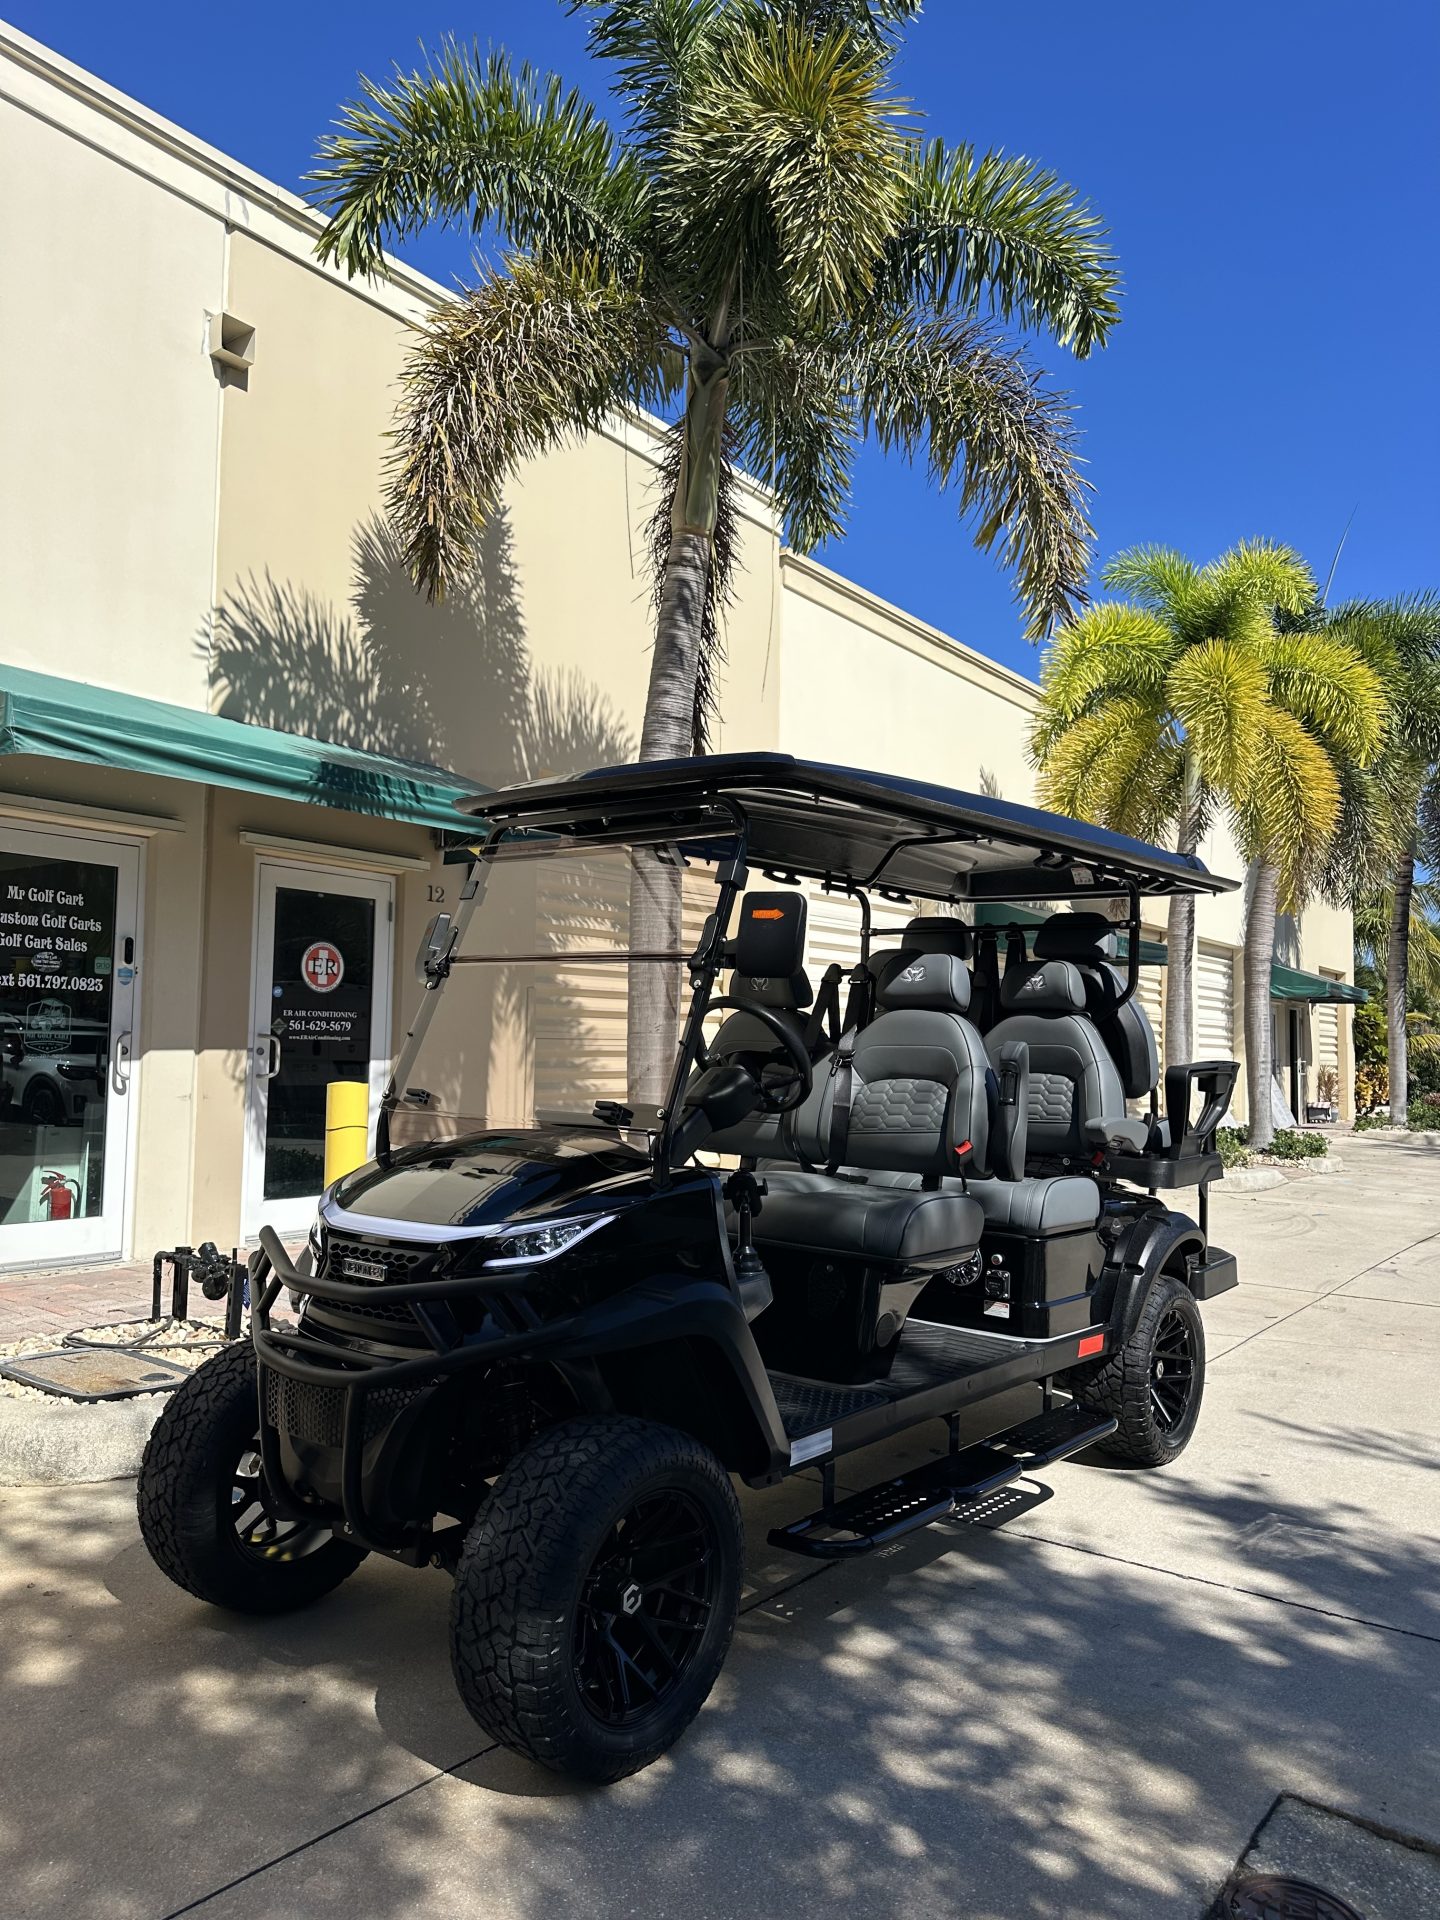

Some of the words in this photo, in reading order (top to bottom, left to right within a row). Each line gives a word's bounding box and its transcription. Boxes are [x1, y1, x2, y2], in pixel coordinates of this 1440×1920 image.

[7, 885, 25, 900] Mr
[28, 887, 54, 903] Golf
[56, 890, 84, 906] Cart
[426, 885, 445, 903] 12
[0, 912, 39, 926] ustom
[42, 913, 67, 929] Golf
[69, 916, 102, 932] Carts
[24, 934, 53, 950] Cart
[55, 936, 88, 952] Sales
[311, 957, 337, 976] ER
[17, 973, 104, 992] 561.797.0823
[283, 1009, 293, 1017] ER
[307, 1010, 358, 1019] CONDITIONING
[288, 1020, 351, 1031] 561-629-5679
